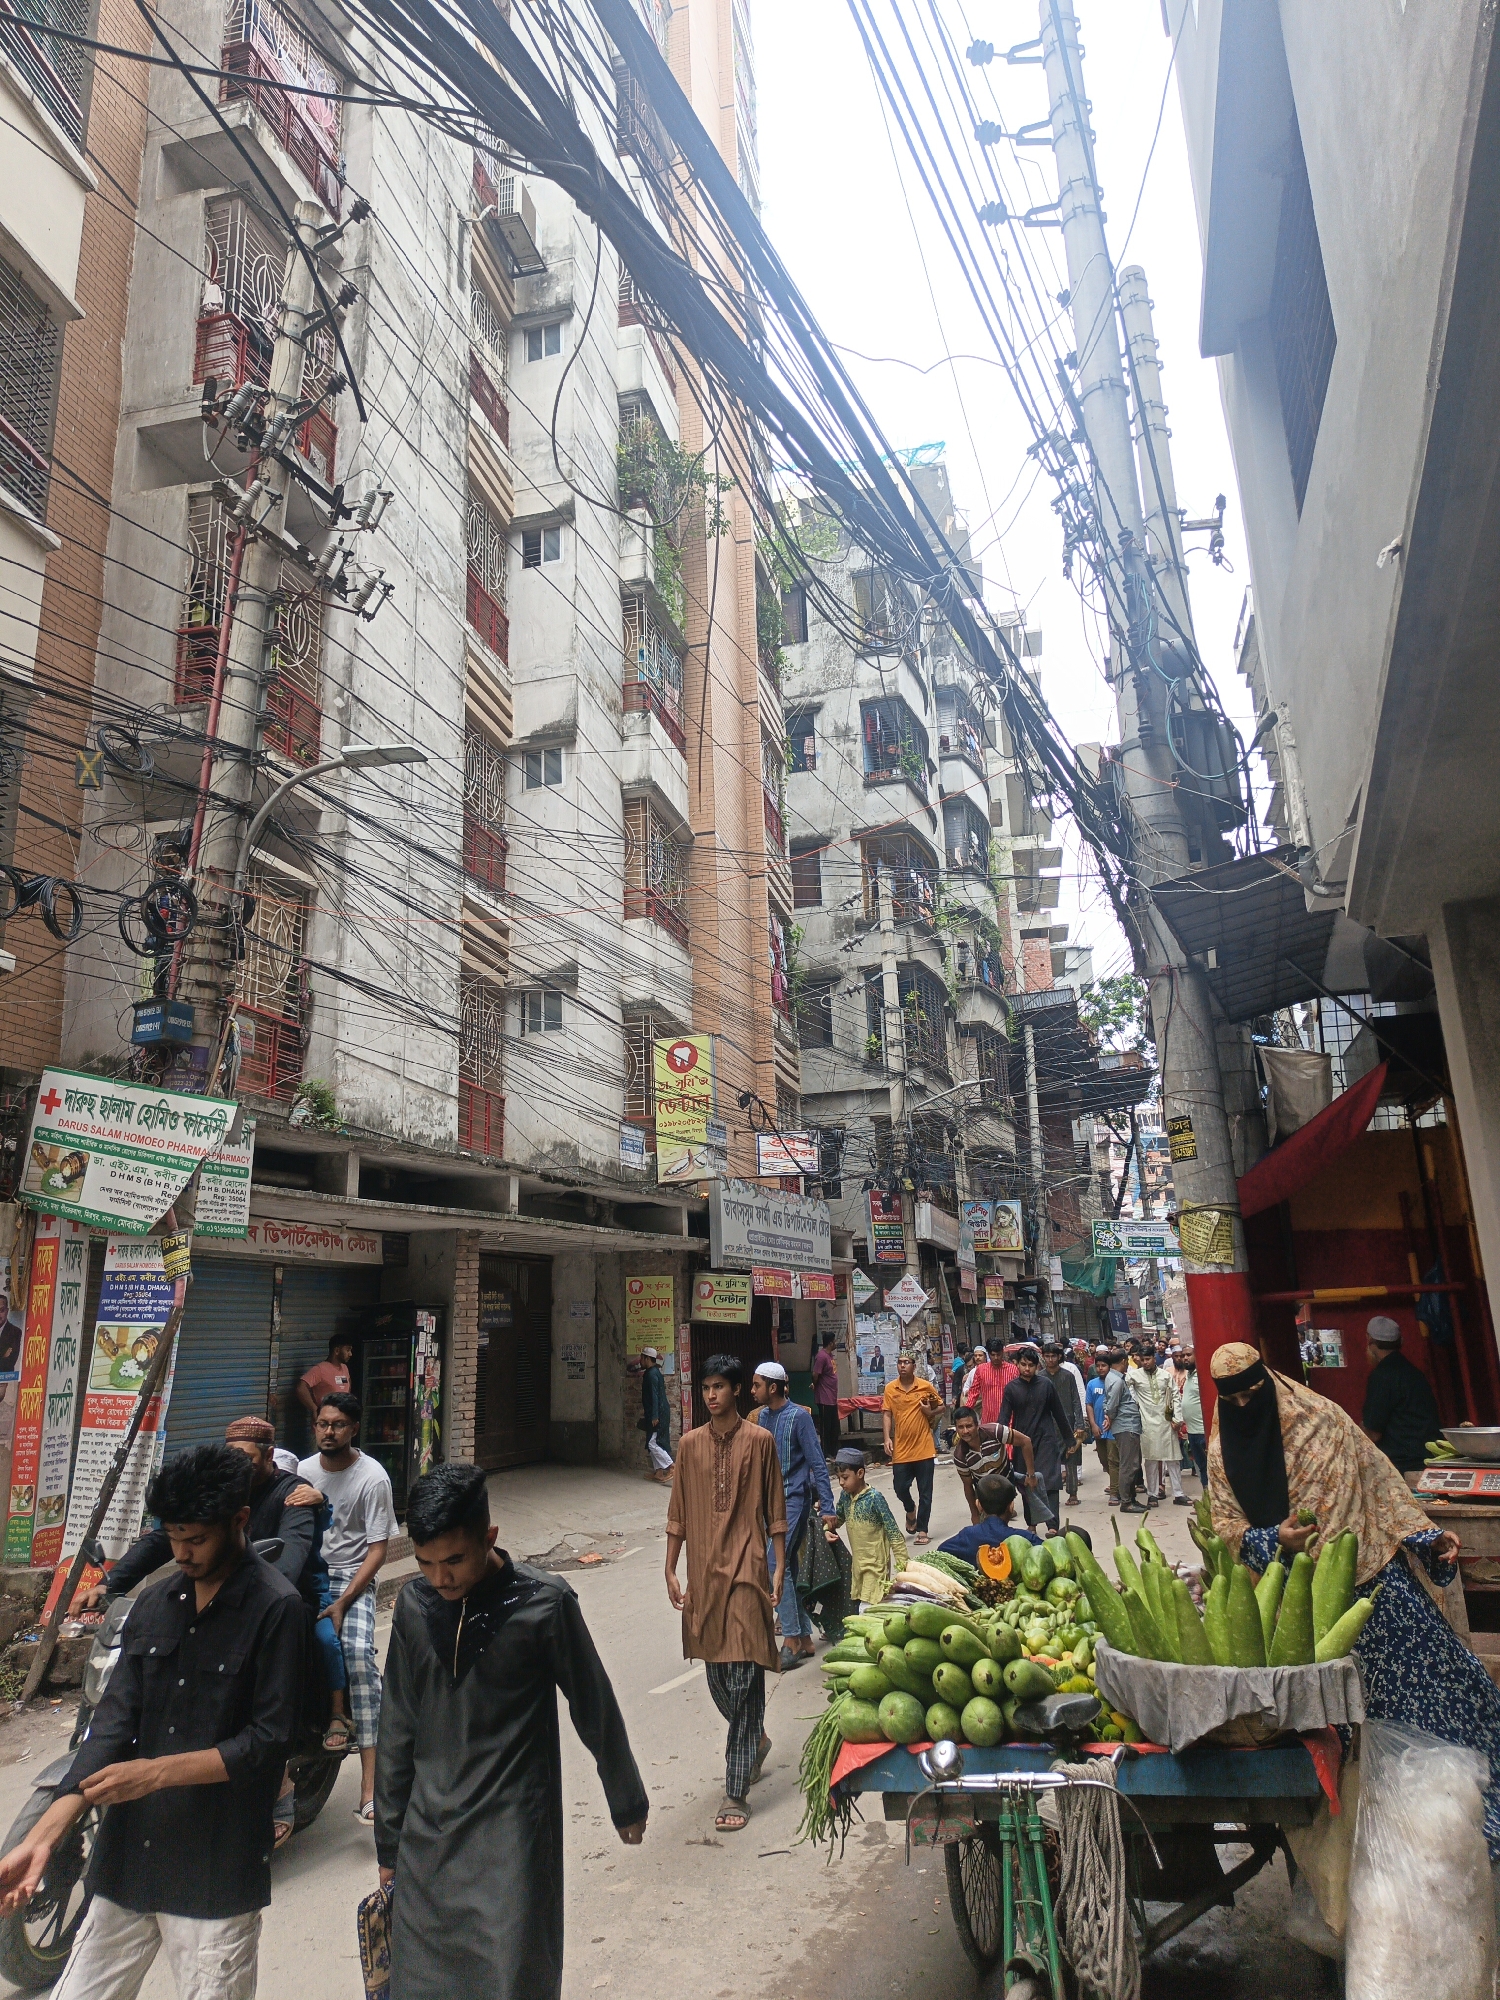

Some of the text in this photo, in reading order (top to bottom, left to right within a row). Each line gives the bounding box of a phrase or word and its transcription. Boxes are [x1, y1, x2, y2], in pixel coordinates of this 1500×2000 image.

[658, 1094, 712, 1115] ডেন্টাল
[64, 1088, 99, 1120] দারুছ
[100, 1094, 137, 1124] ছালাম
[136, 1098, 180, 1132] হোমিও
[184, 1108, 228, 1143] ফার্মেসী
[58, 1118, 88, 1132] DARUS
[90, 1124, 121, 1140] SALAM
[124, 1132, 164, 1148] HOMOEO
[212, 1152, 250, 1164] PHARMACY
[94, 1156, 105, 1167] ডা.
[154, 1168, 178, 1182] কবীর
[222, 1188, 246, 1196] DHAKA)
[225, 1180, 248, 1188] হোসেন
[213, 1194, 227, 1202] Reg:
[968, 1220, 988, 1228] বিউটি
[162, 1234, 187, 1250] টিচার
[263, 1221, 343, 1251] ডিপার্টমেন্টাল
[348, 1234, 378, 1254] স্টোর
[37, 1242, 54, 1280] দারুছ
[64, 1235, 84, 1278] দারুছ
[140, 1272, 156, 1282] কবীর
[148, 1284, 171, 1292] DHAKA)
[32, 1281, 50, 1320] ছালাম
[60, 1278, 81, 1320] ছালাম
[628, 1294, 671, 1314] ডেন্টাল
[713, 1292, 747, 1306] ডেন্টাল
[26, 1324, 46, 1372] হোমিও
[54, 1324, 76, 1375] হোমিও
[21, 1374, 42, 1421] ফার্মেসী
[48, 1378, 74, 1429] ফার্মেসী
[87, 1398, 98, 1406] পুরুষ,
[100, 1396, 114, 1406] মহিলা,
[88, 1406, 104, 1415] মানসিক
[107, 1408, 122, 1416] রোগের
